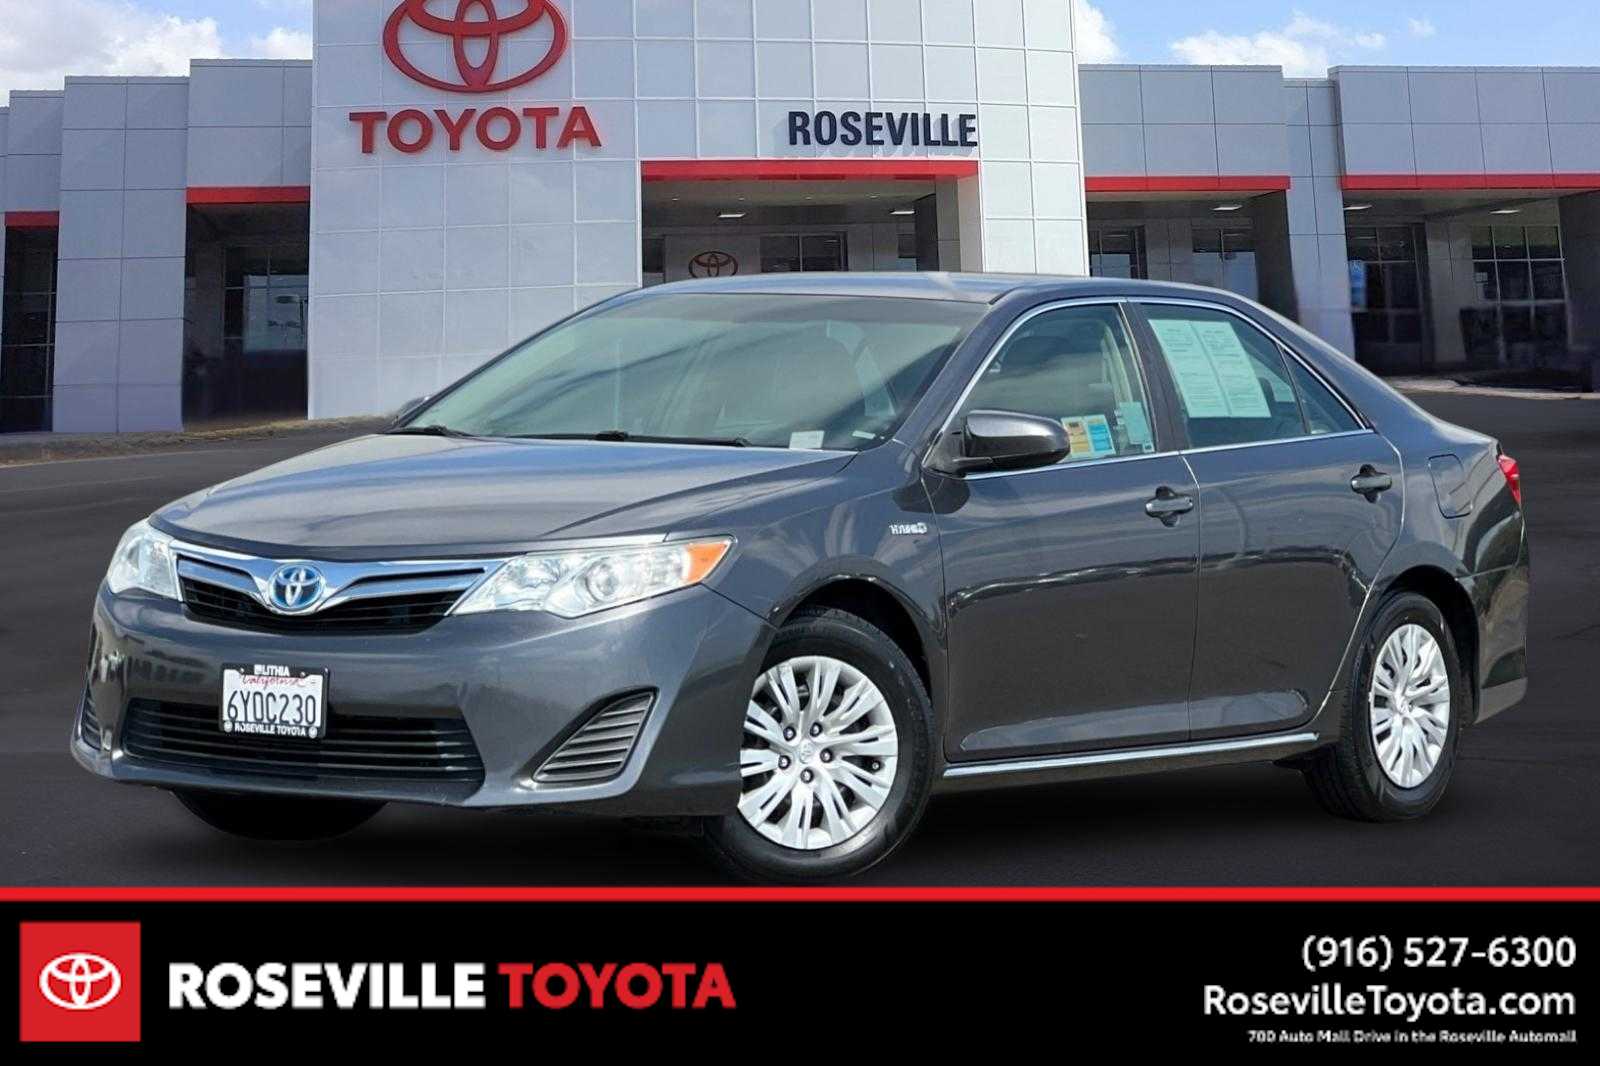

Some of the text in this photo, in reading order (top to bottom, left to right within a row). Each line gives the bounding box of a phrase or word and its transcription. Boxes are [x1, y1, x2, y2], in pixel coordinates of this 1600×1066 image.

[349, 106, 602, 154] TOYOTA
[788, 111, 978, 147] ROSEVILLE
[234, 722, 307, 736] ROSEVILLE TOYOTA
